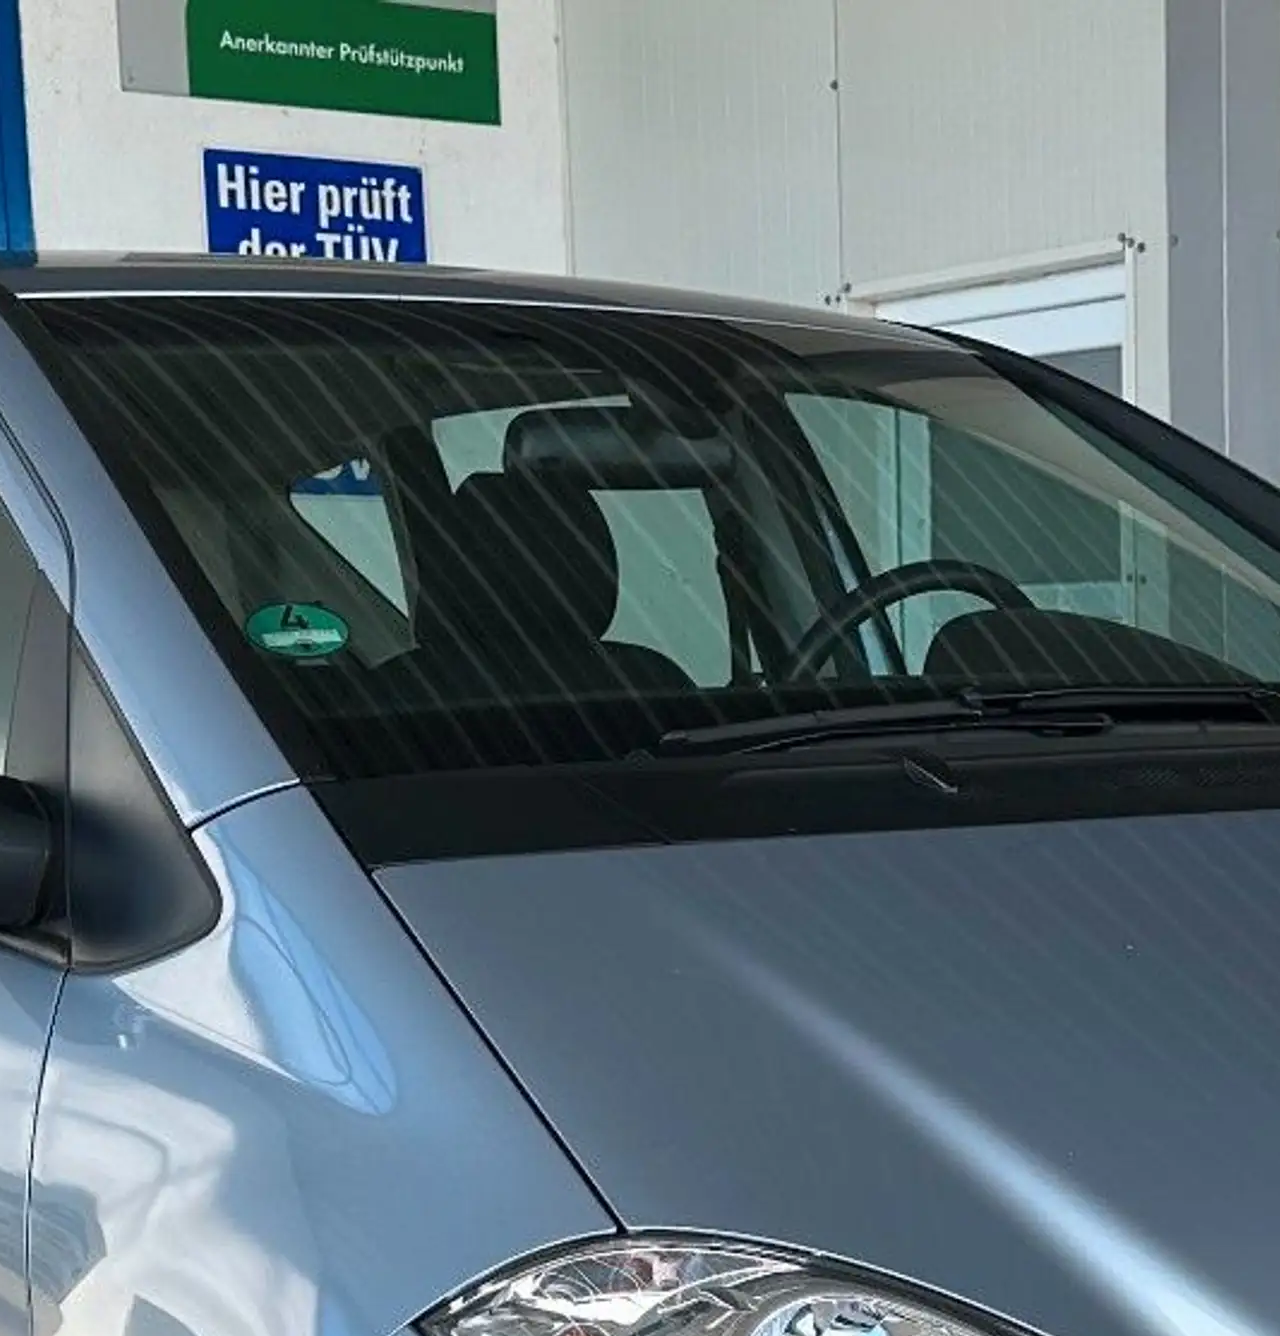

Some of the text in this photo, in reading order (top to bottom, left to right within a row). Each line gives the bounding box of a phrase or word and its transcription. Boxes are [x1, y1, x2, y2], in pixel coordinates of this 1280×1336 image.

[220, 29, 464, 74] Anerkannter Prüfstützpunkt
[217, 163, 413, 230] Hier prüft
[315, 223, 399, 263] TÜV
